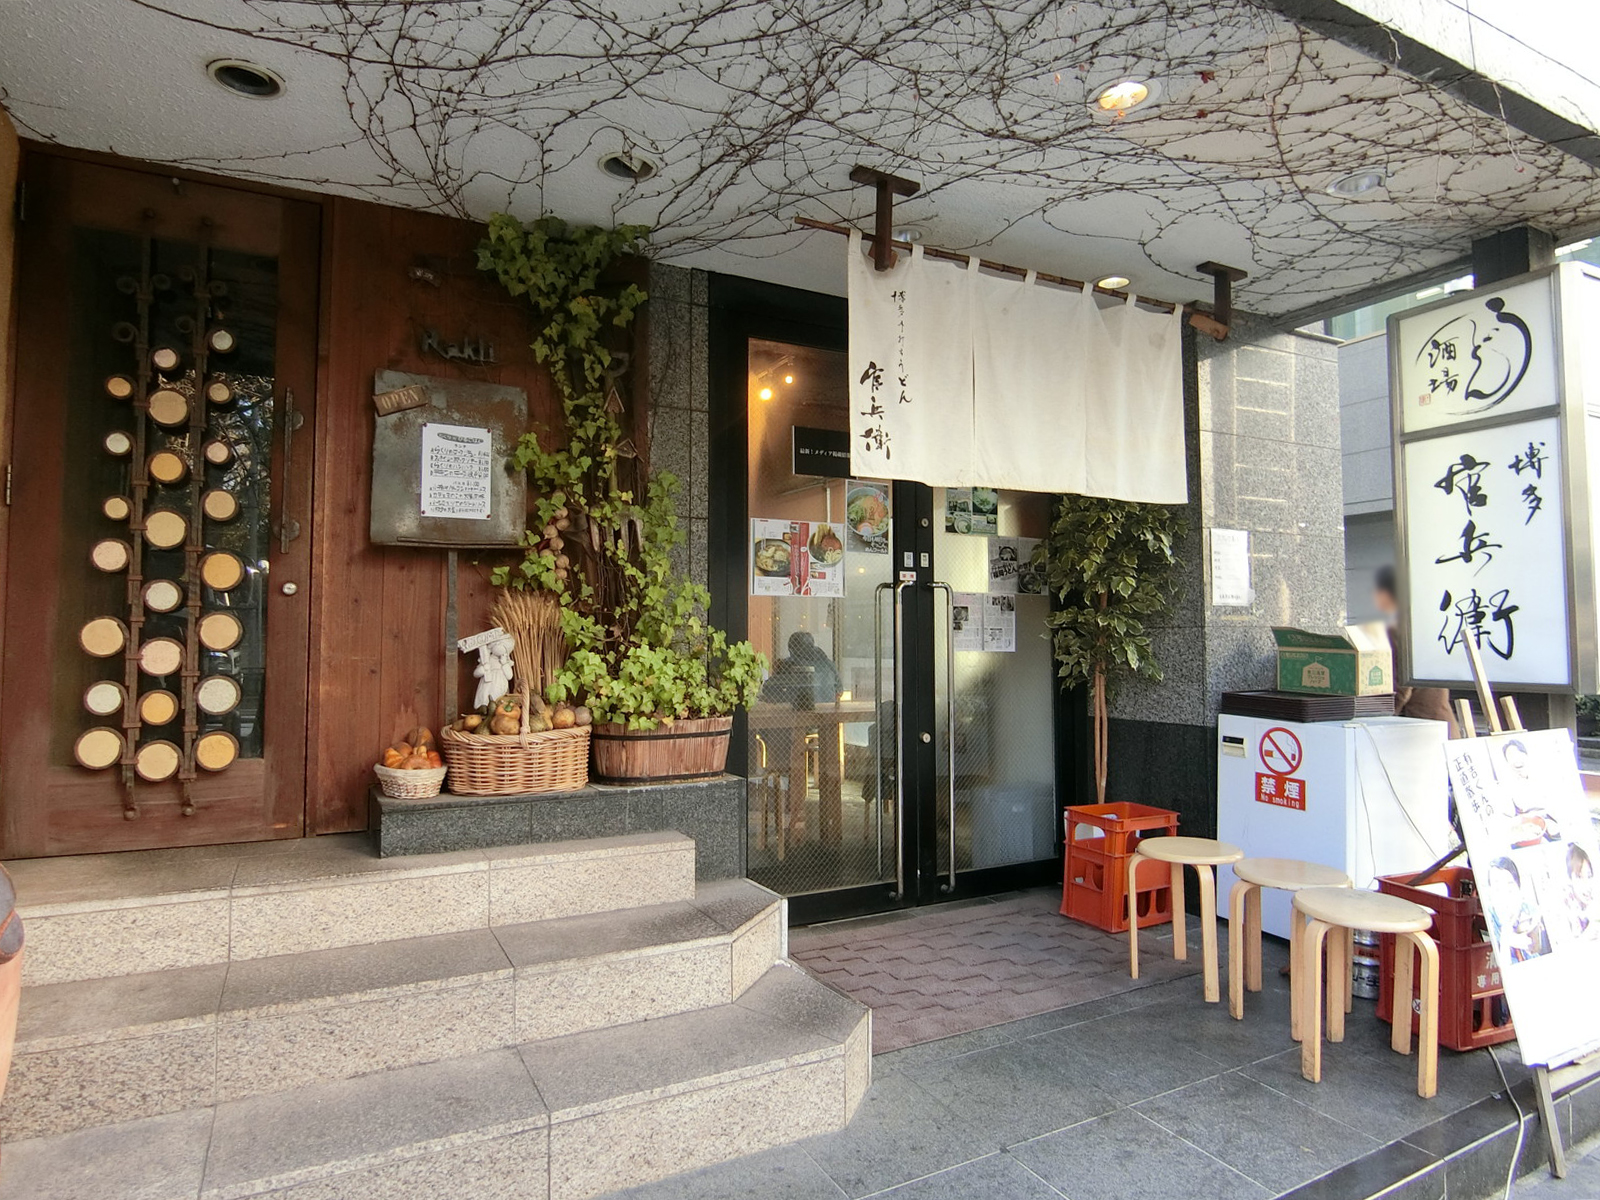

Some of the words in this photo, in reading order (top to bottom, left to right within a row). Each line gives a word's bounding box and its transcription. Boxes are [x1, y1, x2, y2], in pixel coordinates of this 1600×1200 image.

[380, 388, 420, 410] OPEN
[1507, 441, 1550, 526] 博多
[1261, 776, 1300, 800] 禁煙
[1260, 792, 1269, 802] No
[1272, 796, 1300, 809] smoking
